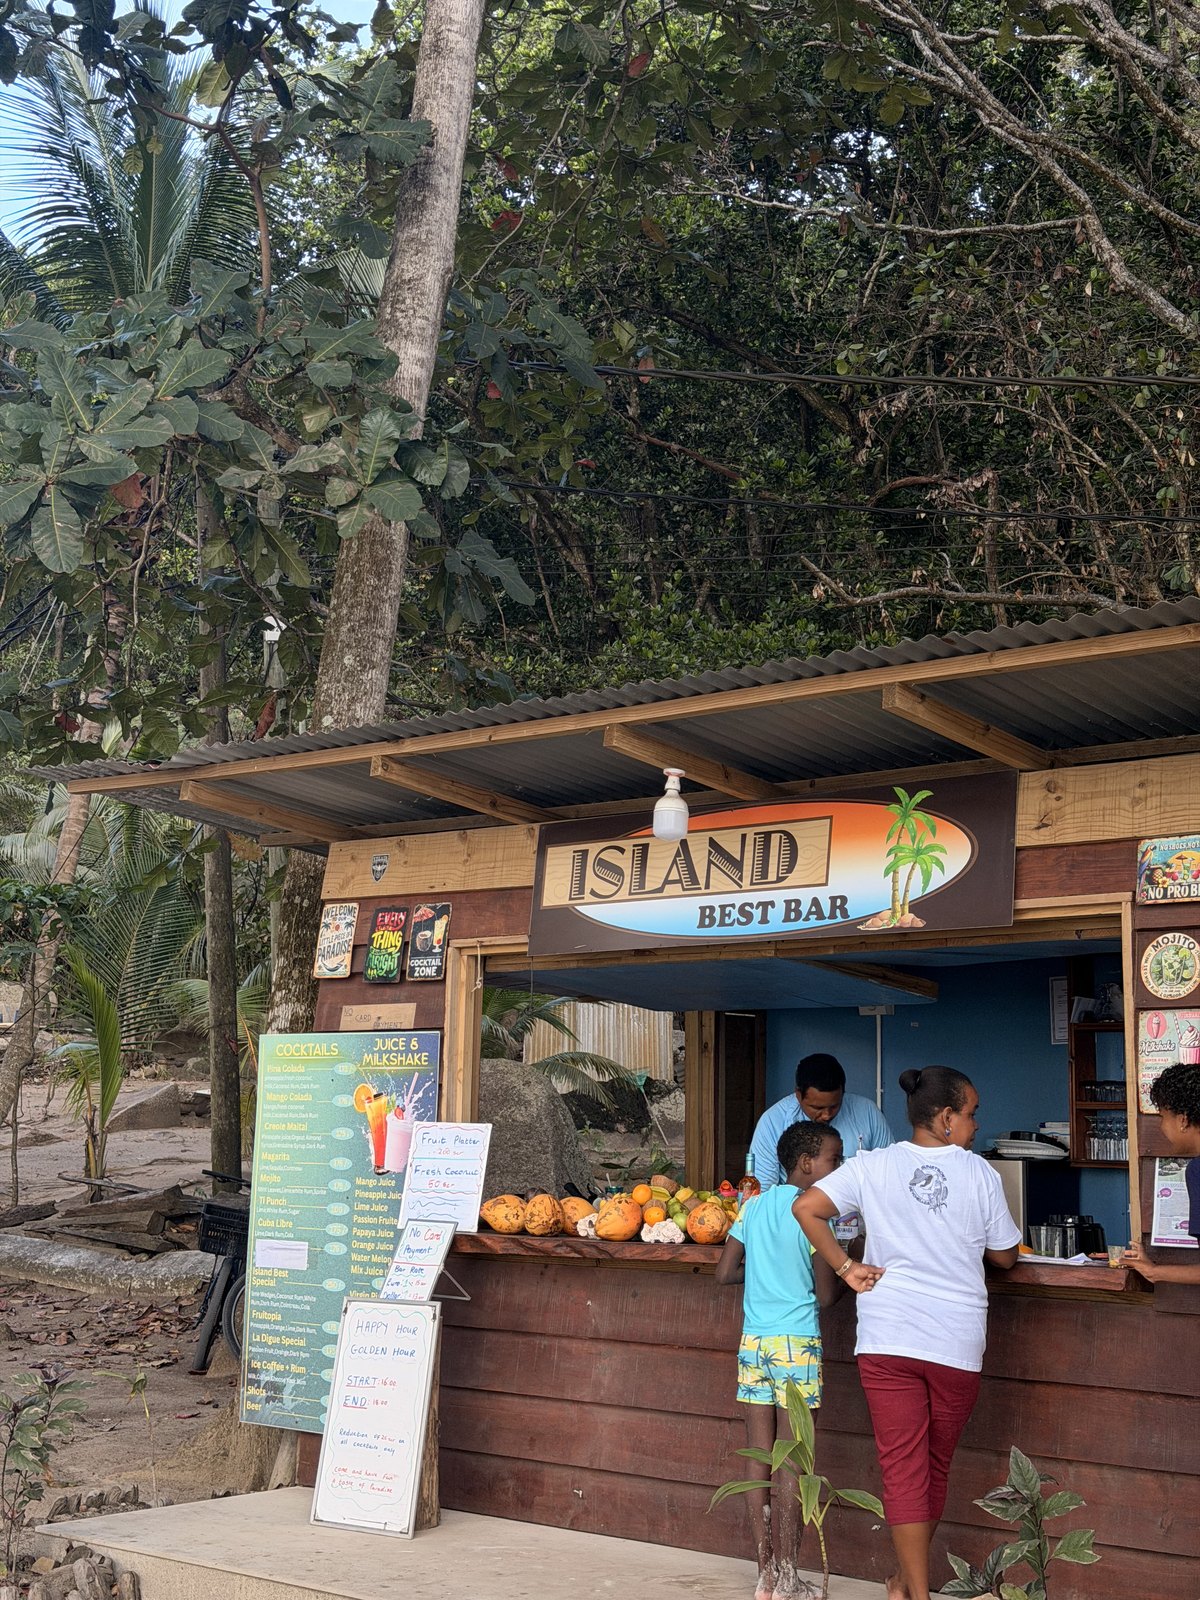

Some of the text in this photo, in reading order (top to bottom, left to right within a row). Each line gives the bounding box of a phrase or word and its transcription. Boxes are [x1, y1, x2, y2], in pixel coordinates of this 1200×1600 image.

[570, 829, 798, 900] ISLAND
[1148, 886, 1164, 900] NO
[323, 905, 358, 920] WELCOME
[698, 895, 850, 928] BEST BAR
[376, 911, 407, 931] EVERY
[319, 935, 335, 946] LITTLE
[335, 932, 346, 942] PIECE
[371, 931, 403, 953] THING
[1151, 934, 1196, 952] MOJITO
[317, 939, 352, 962] PARADISE
[366, 952, 400, 975] ALRIGHT
[410, 959, 442, 967] COCKTAIL
[414, 966, 438, 977] ZONE
[344, 1008, 354, 1016] NO
[355, 1014, 371, 1022] CARD
[373, 1022, 404, 1030] PAYMENT
[276, 1042, 339, 1056] COCKTAILS
[373, 1038, 406, 1050] JUICE
[1140, 1040, 1176, 1056] Milkshake
[363, 1052, 429, 1066] MILKSHAKE
[266, 1092, 312, 1102] Mango Colada
[264, 1123, 286, 1131] Creole
[421, 1132, 480, 1145] Fruit Platter
[261, 1152, 290, 1163] Magarita
[414, 1164, 479, 1176] Fresh Coconut
[260, 1174, 281, 1184] Mojito
[355, 1177, 377, 1187] Mango
[378, 1178, 396, 1187] Juice
[428, 1179, 440, 1188] 50
[355, 1190, 403, 1200] Pineapple Juic
[267, 1197, 286, 1206] Punch
[354, 1203, 370, 1212] Lime
[370, 1204, 388, 1212] Juice
[258, 1218, 293, 1228] Cuba Libre
[353, 1215, 378, 1224] Passion
[352, 1228, 376, 1239] Papaya
[377, 1229, 394, 1238] Juice
[409, 1227, 443, 1241] No Card
[351, 1240, 375, 1251] Orange
[376, 1242, 393, 1251] Juice
[403, 1244, 433, 1258] Payment
[351, 1252, 392, 1264] Water Melon
[253, 1267, 288, 1277] Island Best
[350, 1265, 363, 1274] Mix
[364, 1267, 384, 1276] Juice
[394, 1265, 406, 1273] Bar
[410, 1266, 424, 1274] Rate
[252, 1277, 276, 1287] Special
[252, 1310, 282, 1321] Fruitopia
[355, 1319, 419, 1336] HAPPY HOUR
[253, 1333, 306, 1347] La Digue Special
[350, 1344, 416, 1358] GOLDEN HOUR
[251, 1360, 261, 1369] Ice
[262, 1361, 284, 1371] Coffee
[291, 1364, 306, 1374] Rum
[247, 1386, 266, 1396] Shots
[246, 1401, 261, 1411] Beer
